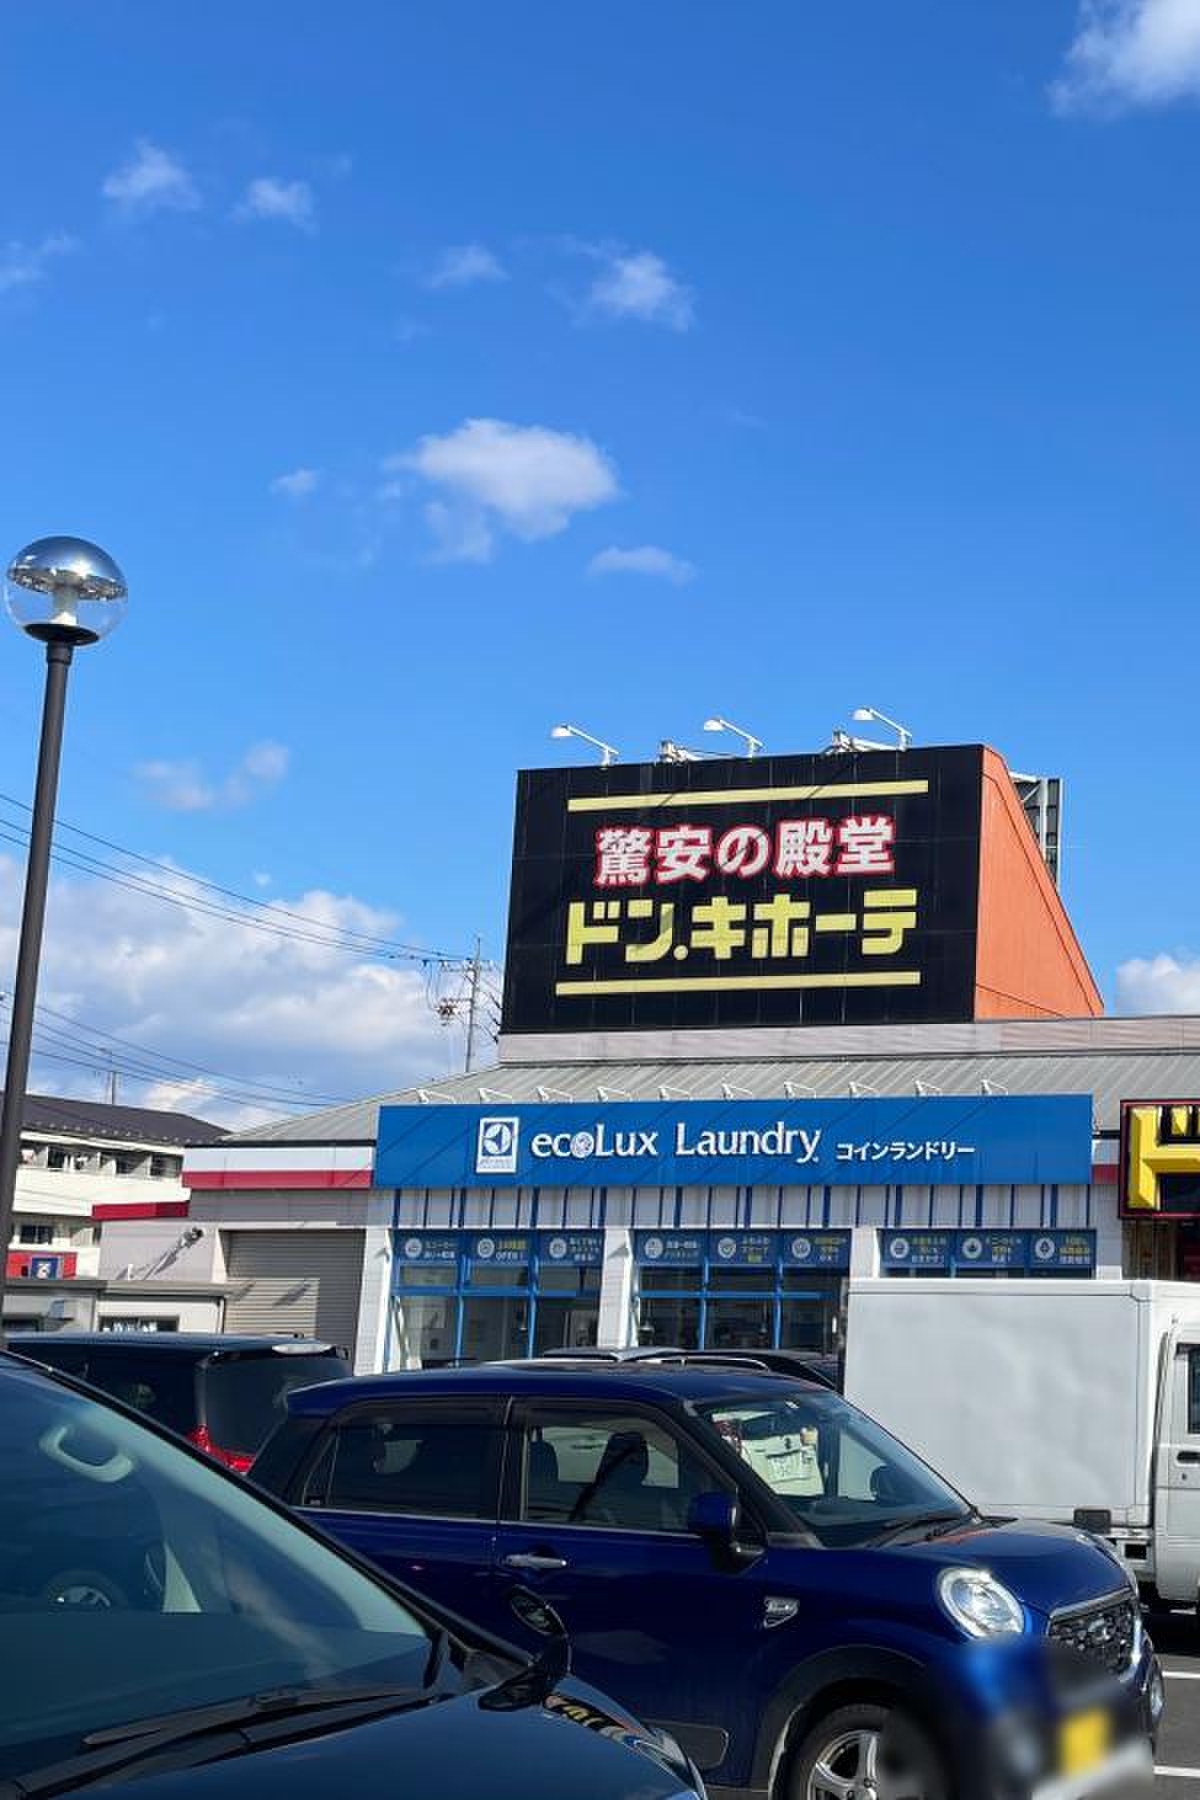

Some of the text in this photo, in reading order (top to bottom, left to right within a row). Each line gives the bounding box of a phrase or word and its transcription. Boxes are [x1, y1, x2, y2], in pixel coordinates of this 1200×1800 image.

[595, 815, 896, 885] 驚安の殿堂
[835, 1139, 976, 1162] コインランドリー
